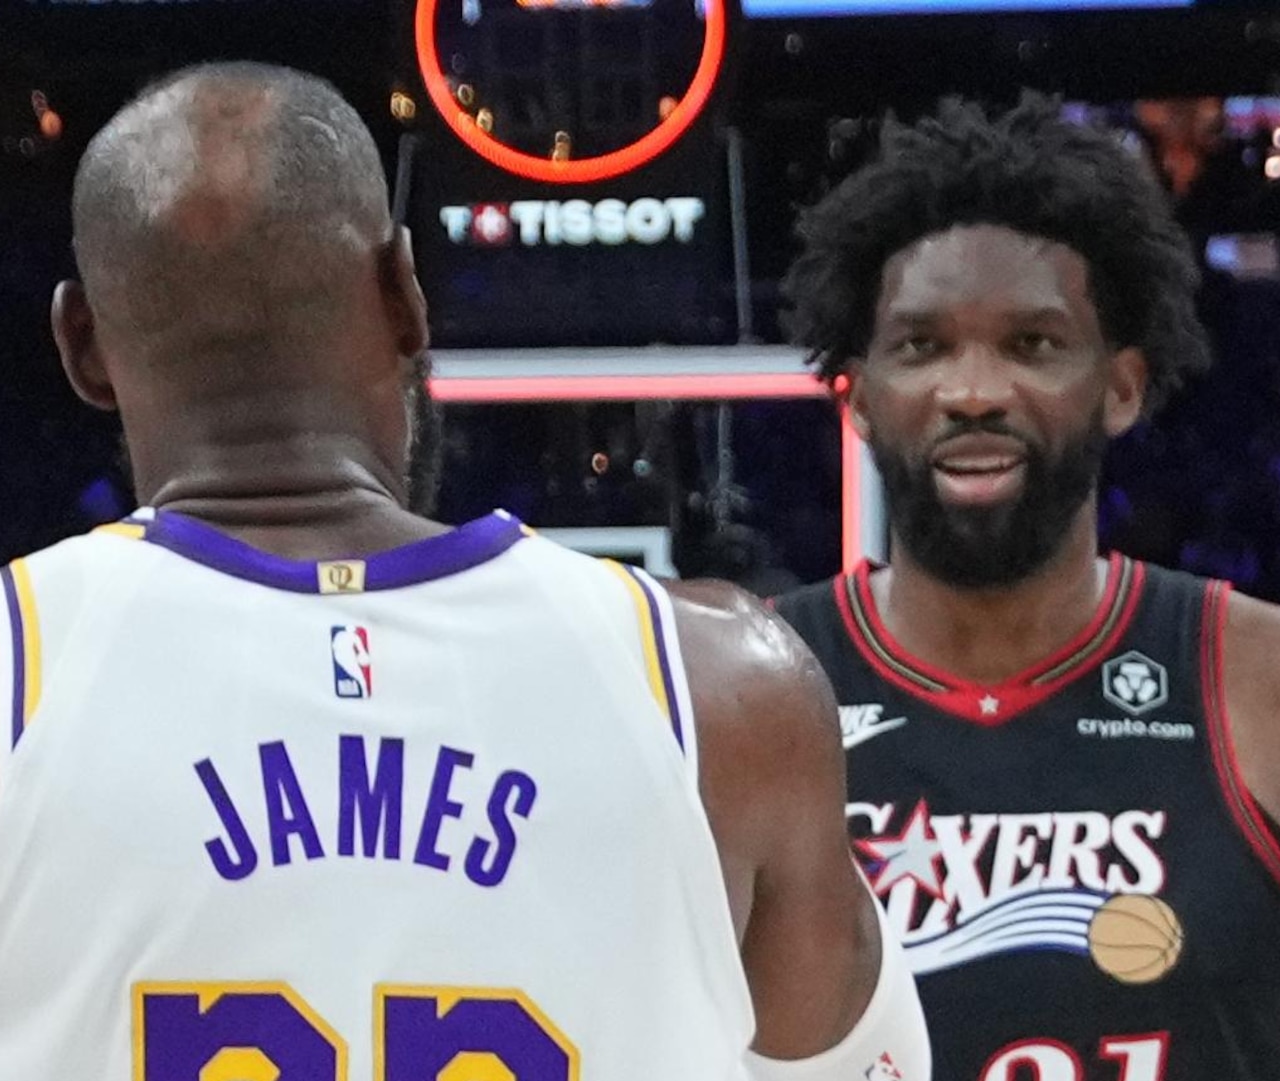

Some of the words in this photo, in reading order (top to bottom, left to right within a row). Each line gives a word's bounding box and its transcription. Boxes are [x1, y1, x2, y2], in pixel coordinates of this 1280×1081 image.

[509, 197, 705, 245] TISSOT
[1076, 717, 1195, 741] crypto.com
[194, 734, 537, 888] JAMES
